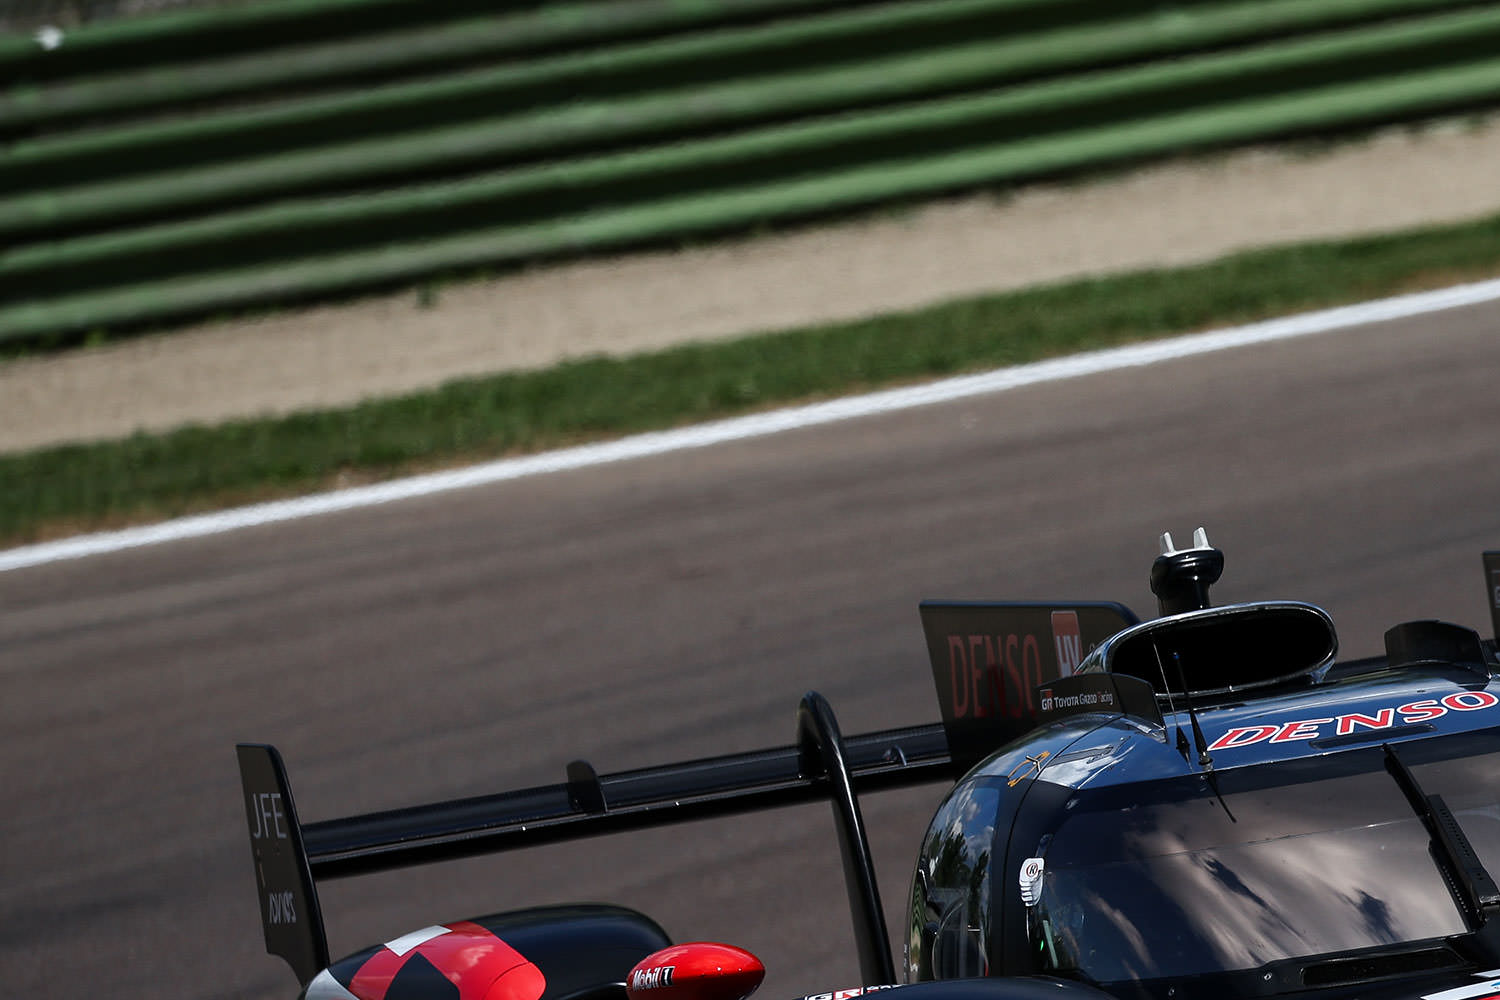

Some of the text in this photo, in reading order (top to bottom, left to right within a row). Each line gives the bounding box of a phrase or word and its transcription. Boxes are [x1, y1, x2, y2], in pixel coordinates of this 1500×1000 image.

[947, 634, 1042, 719] DENSO
[1207, 691, 1499, 751] DENSO
[252, 793, 287, 839] JFE
[633, 967, 661, 991] Mobil
